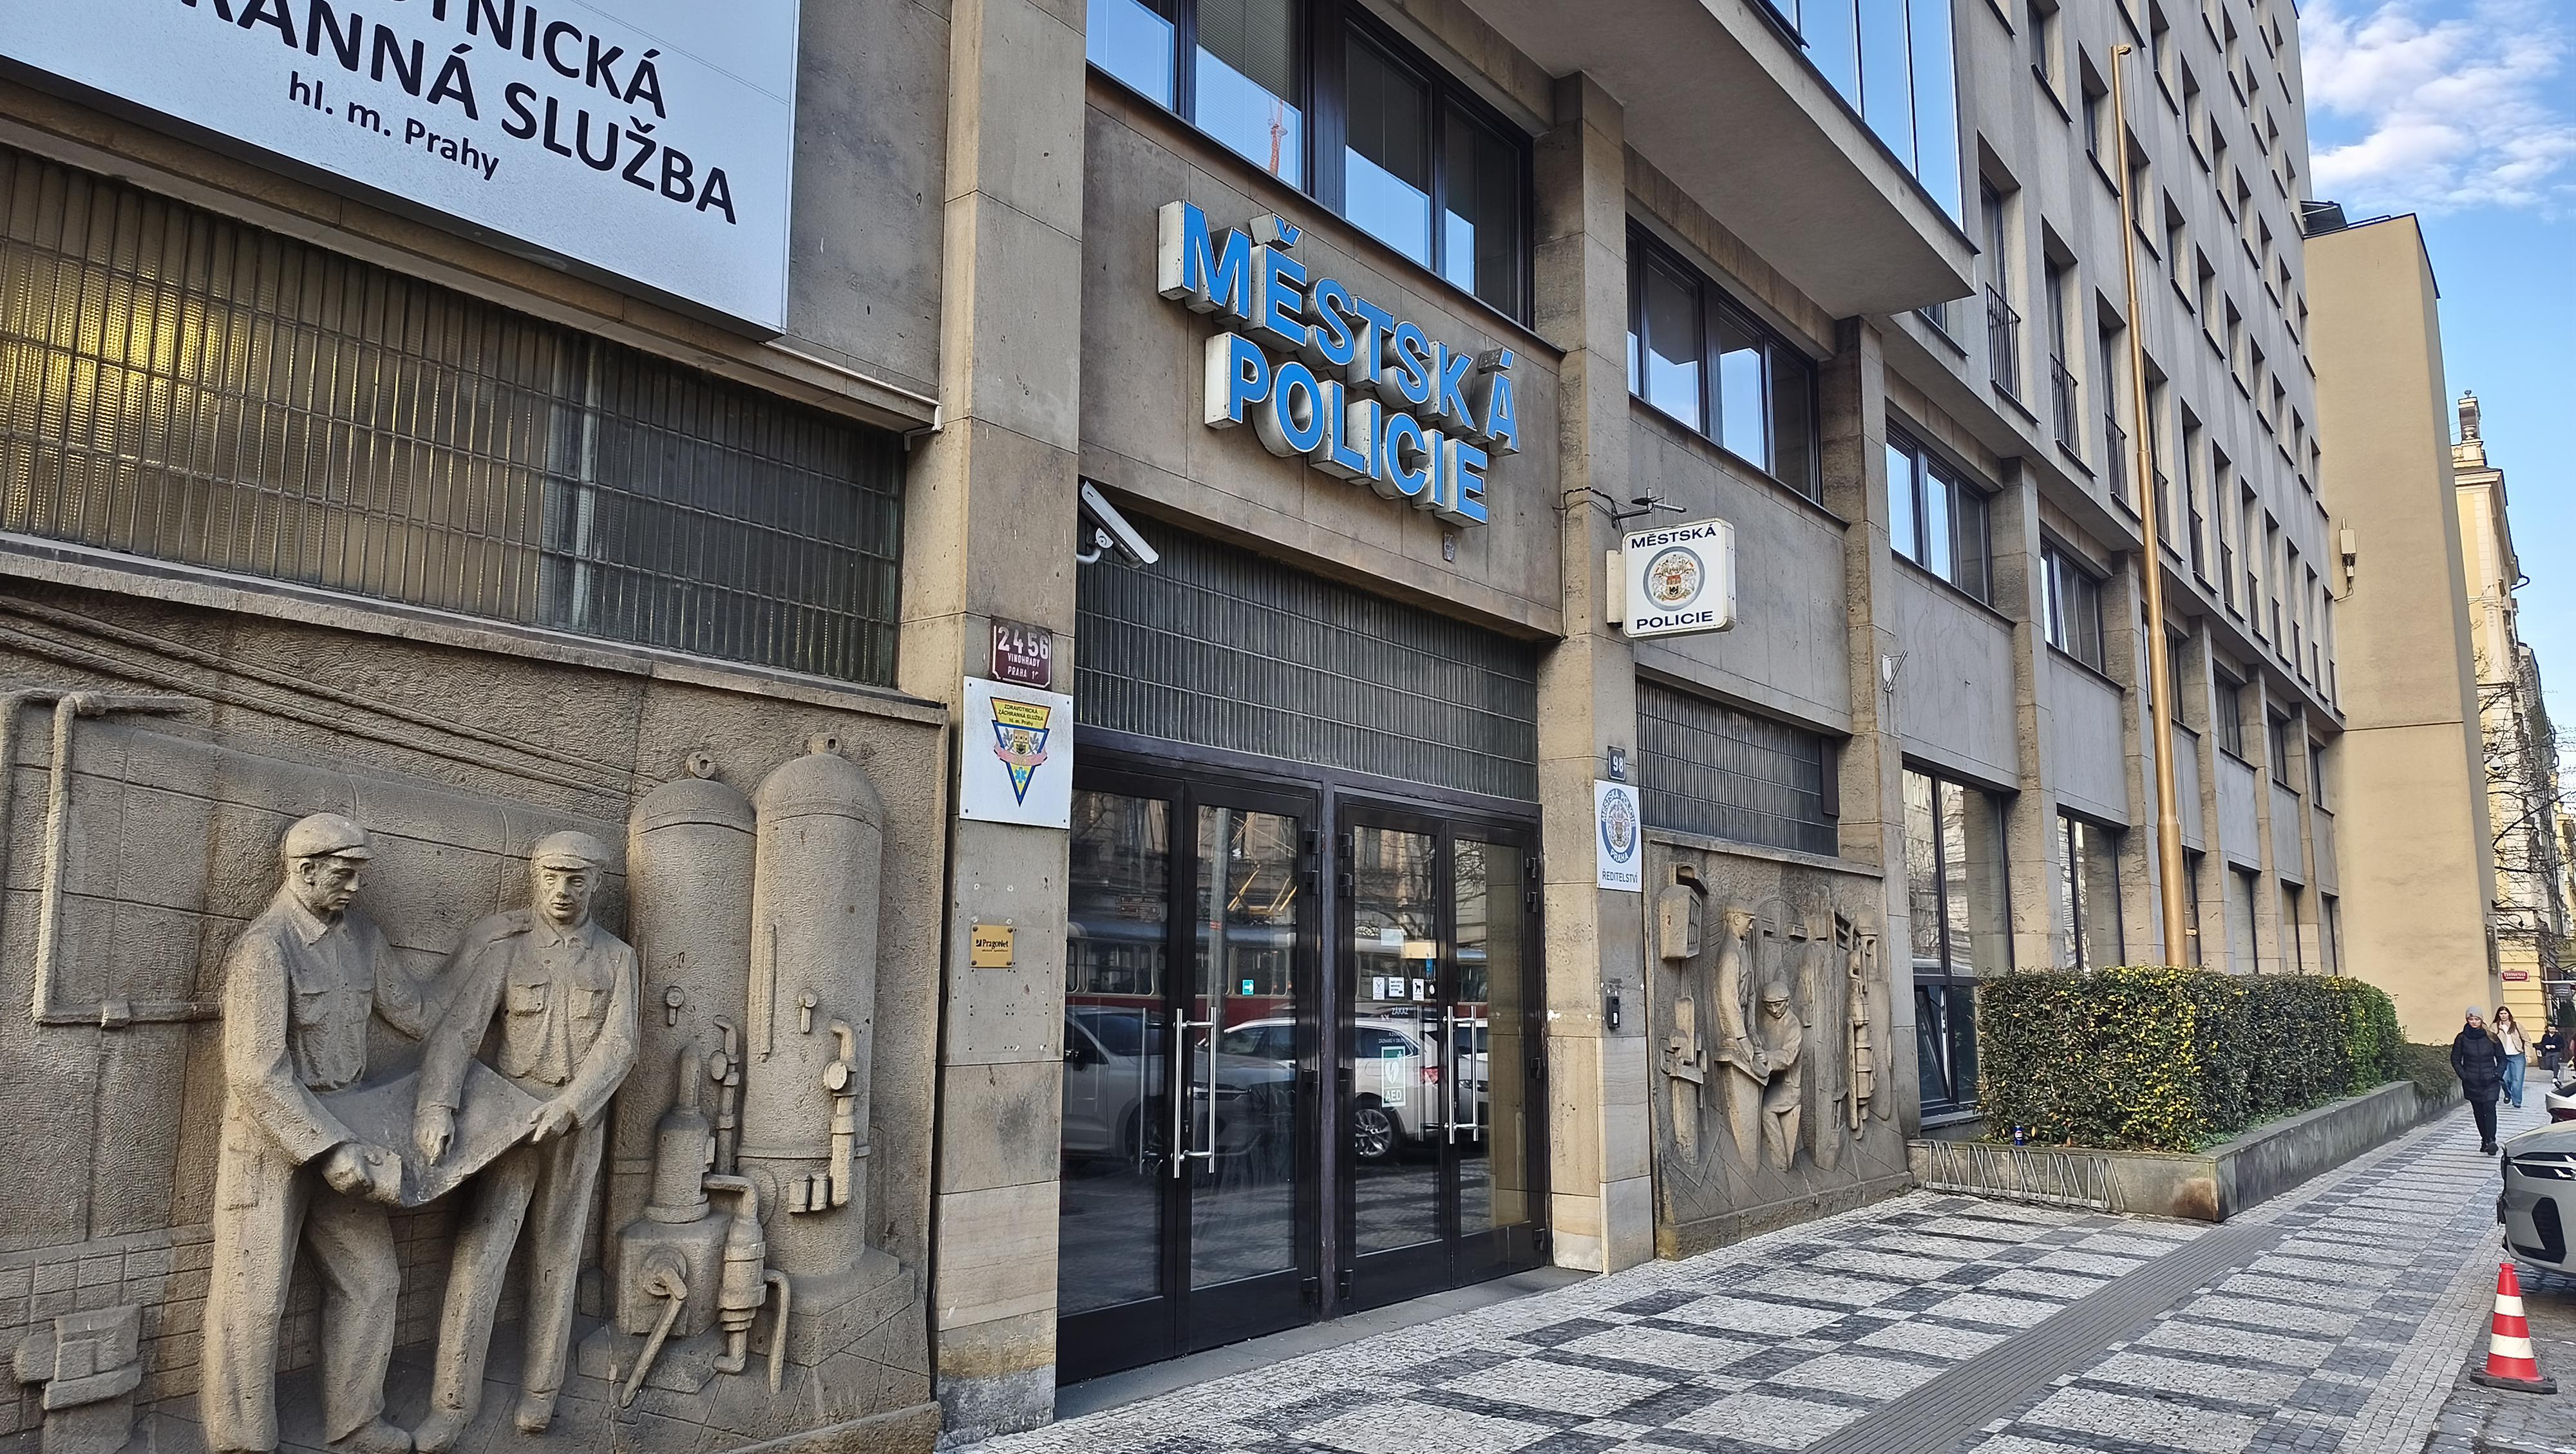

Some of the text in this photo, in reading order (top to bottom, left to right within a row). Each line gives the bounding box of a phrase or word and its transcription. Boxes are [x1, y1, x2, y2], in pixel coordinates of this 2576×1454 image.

[289, 70, 500, 181] hl. m. Prahy
[500, 81, 737, 225] SLUŽBA
[1181, 198, 1520, 454] MĚSTSKÁ
[1228, 331, 1489, 525] POLICIE
[1631, 524, 1717, 549] MĚSTSKÁ
[1636, 610, 1713, 630] POLICIE
[998, 626, 1049, 660] 2456
[1007, 652, 1041, 668] VINOHRADY
[1007, 665, 1027, 678] PRAHA
[1613, 755, 1624, 773] 98
[1610, 848, 1629, 862] PRAHA
[1602, 868, 1638, 884] ŘEDITELSTVÍ
[1385, 1090, 1402, 1102] AED
